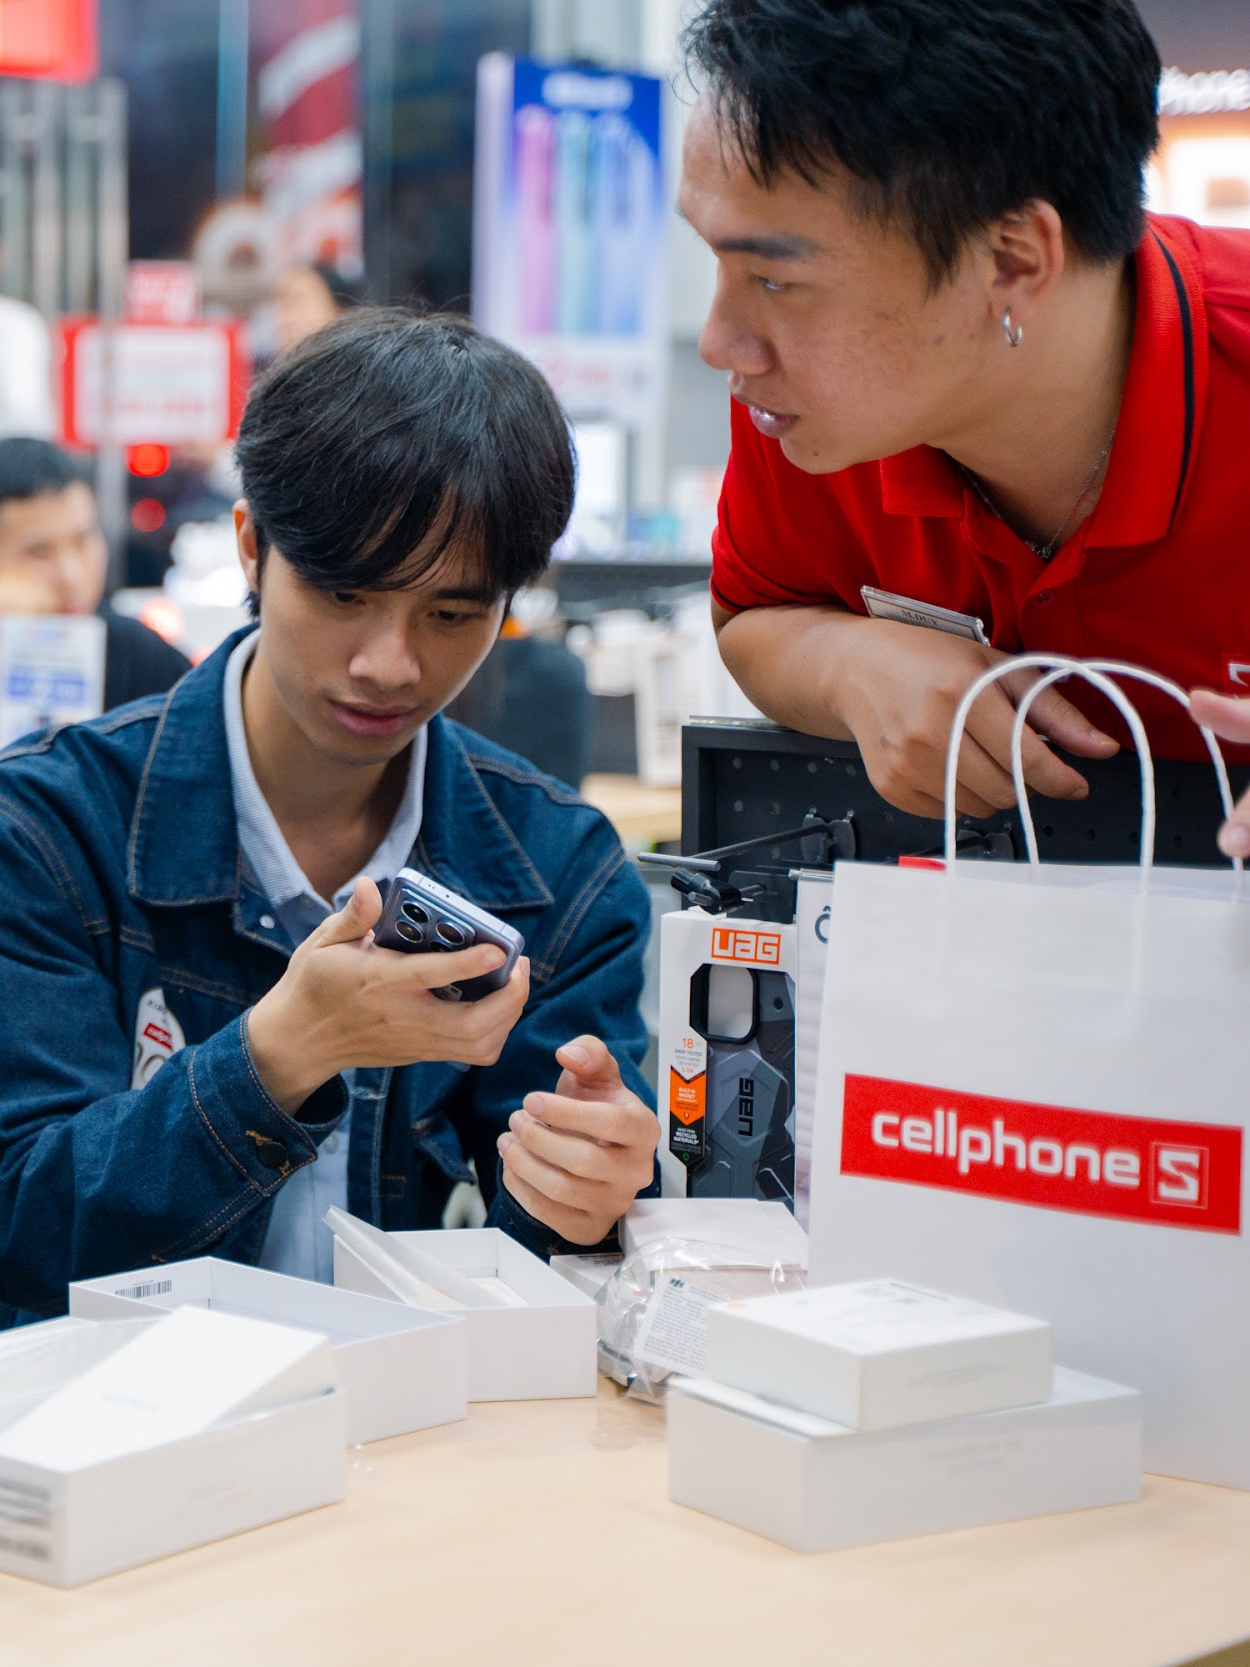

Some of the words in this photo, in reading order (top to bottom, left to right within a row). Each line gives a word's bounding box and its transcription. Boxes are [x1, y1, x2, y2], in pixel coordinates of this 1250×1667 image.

[682, 1037, 694, 1049] 18
[871, 1110, 1141, 1188] cellphone
[1157, 1148, 1200, 1202] S
